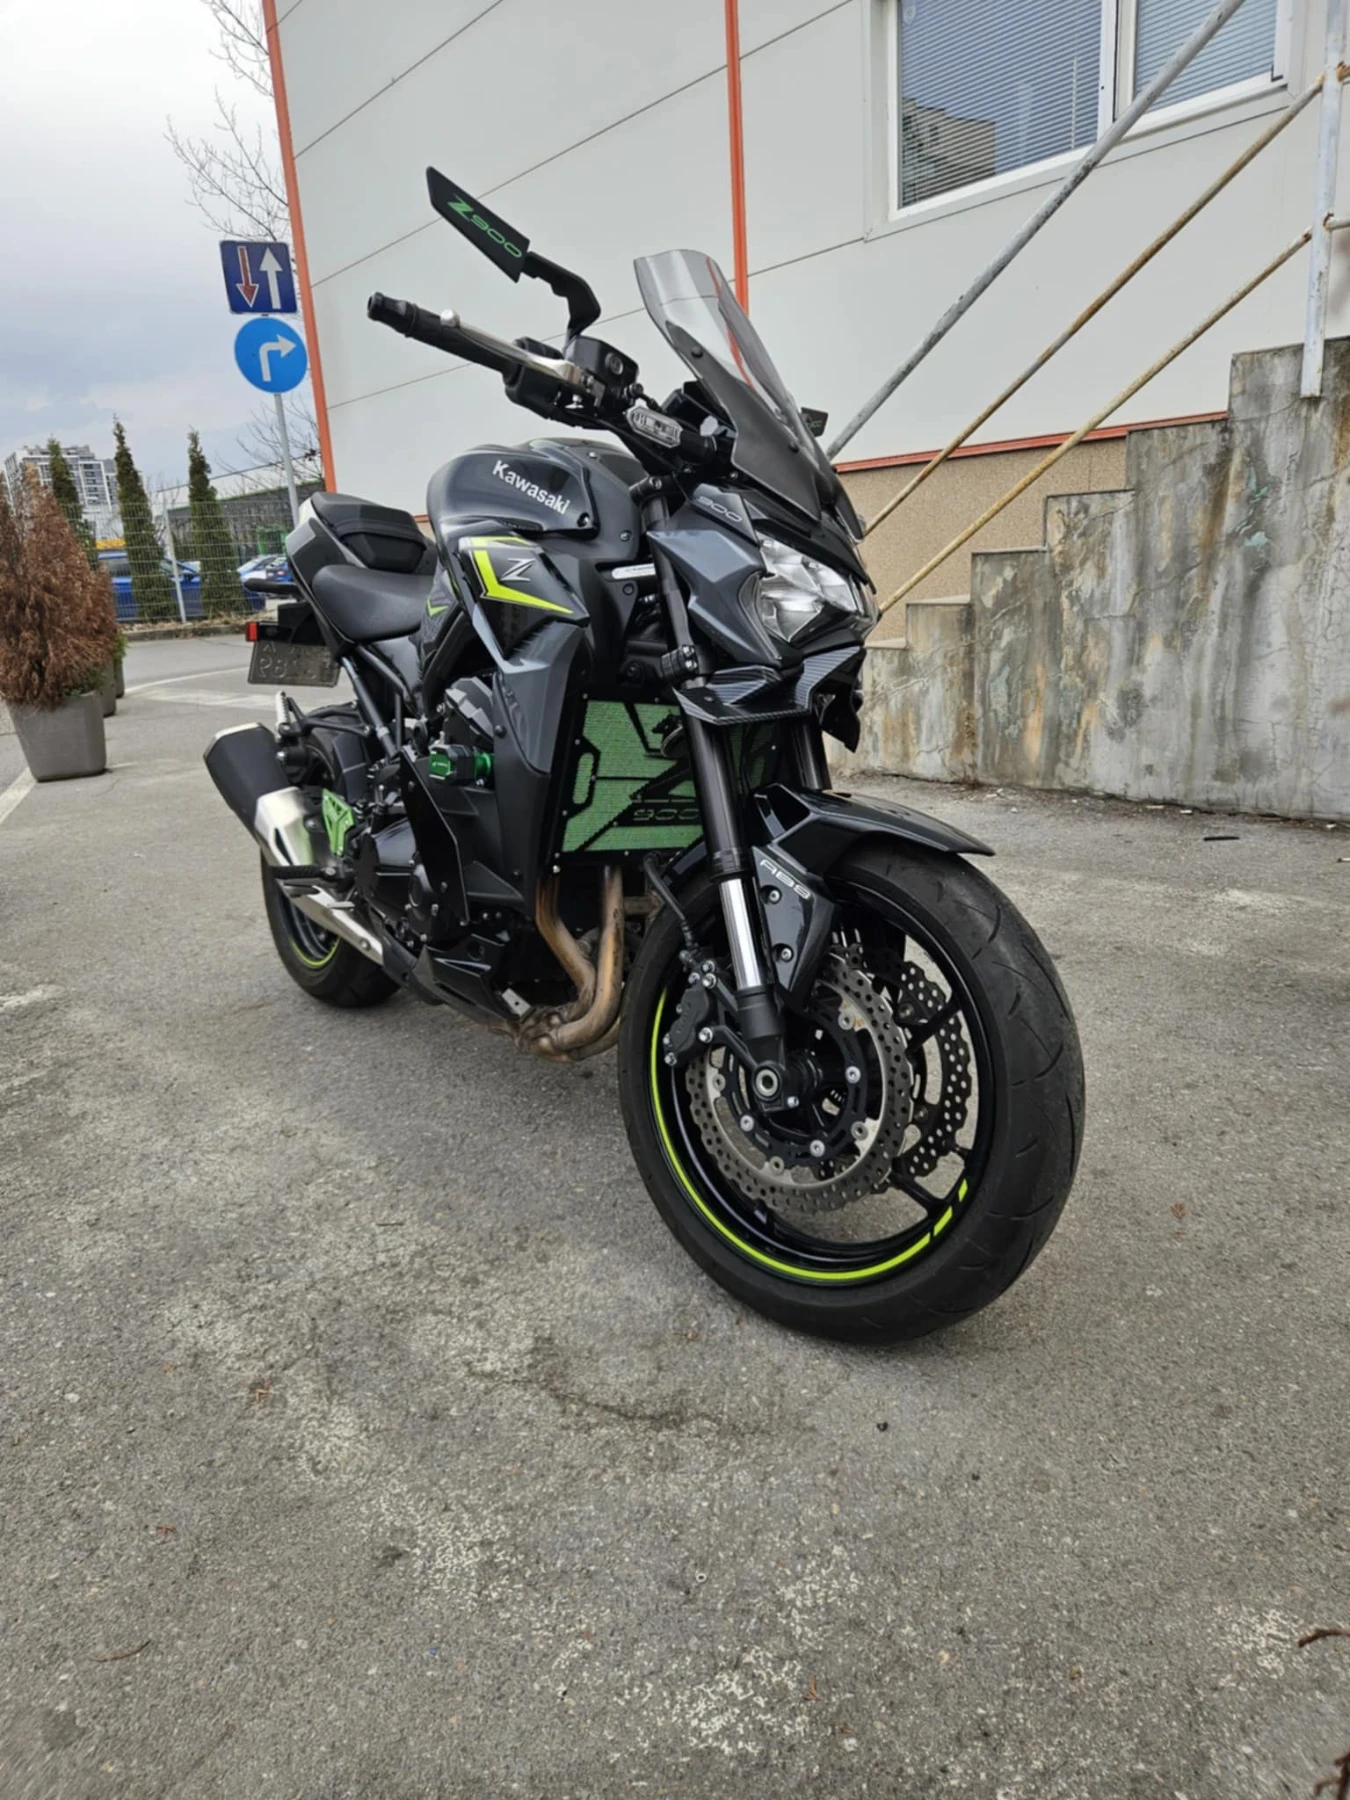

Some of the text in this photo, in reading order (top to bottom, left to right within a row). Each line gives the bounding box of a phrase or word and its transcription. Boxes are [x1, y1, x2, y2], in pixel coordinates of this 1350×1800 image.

[448, 193, 522, 258] Z900
[492, 460, 571, 515] Kawasaki
[696, 495, 742, 522] 900
[501, 557, 536, 582] Z
[759, 858, 811, 900] ABS
